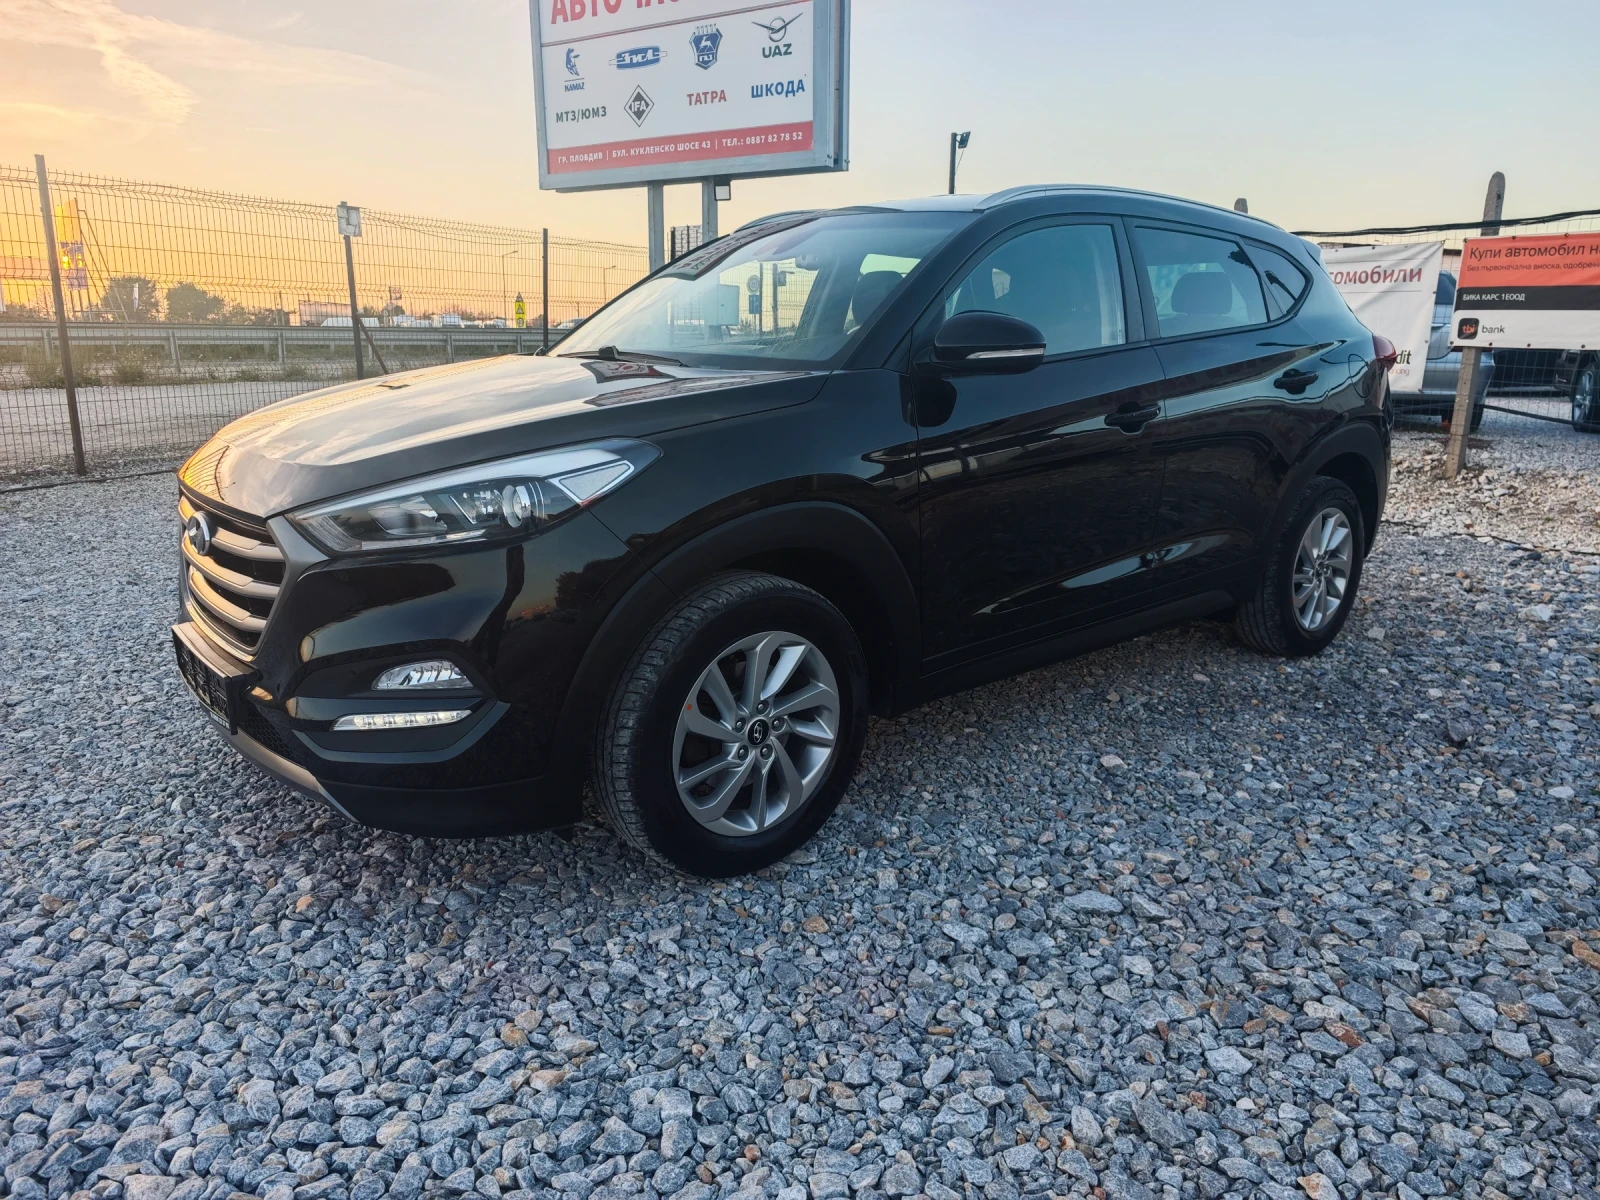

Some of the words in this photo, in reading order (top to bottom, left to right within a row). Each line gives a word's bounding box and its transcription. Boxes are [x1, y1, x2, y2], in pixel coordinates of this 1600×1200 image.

[762, 43, 793, 58] UAZ
[564, 82, 585, 92] KAMAZ
[751, 79, 806, 98] ШКОДА
[687, 90, 727, 106] ТАТРА
[631, 101, 647, 112] IFA
[555, 106, 607, 123] МТЗ/ЮМЗ
[558, 156, 568, 164] ГР.
[569, 152, 603, 163] ПЛОВДИВ
[612, 150, 629, 158] БУЛ.
[630, 144, 675, 156] КУКЛЕНСКО
[677, 141, 700, 151] ШОСЕ
[701, 140, 711, 149] 43
[745, 135, 765, 145] 0887
[767, 134, 778, 143] 82
[780, 132, 790, 141] 78
[792, 131, 803, 140] 52
[1469, 247, 1502, 261] Купи
[1505, 243, 1585, 258] автомобил
[1589, 244, 1600, 255] н
[1329, 265, 1422, 285] омобили
[1467, 264, 1480, 272] Без
[1462, 293, 1481, 301] БИКА
[1481, 293, 1500, 301] КАРС
[1481, 325, 1505, 334] bank
